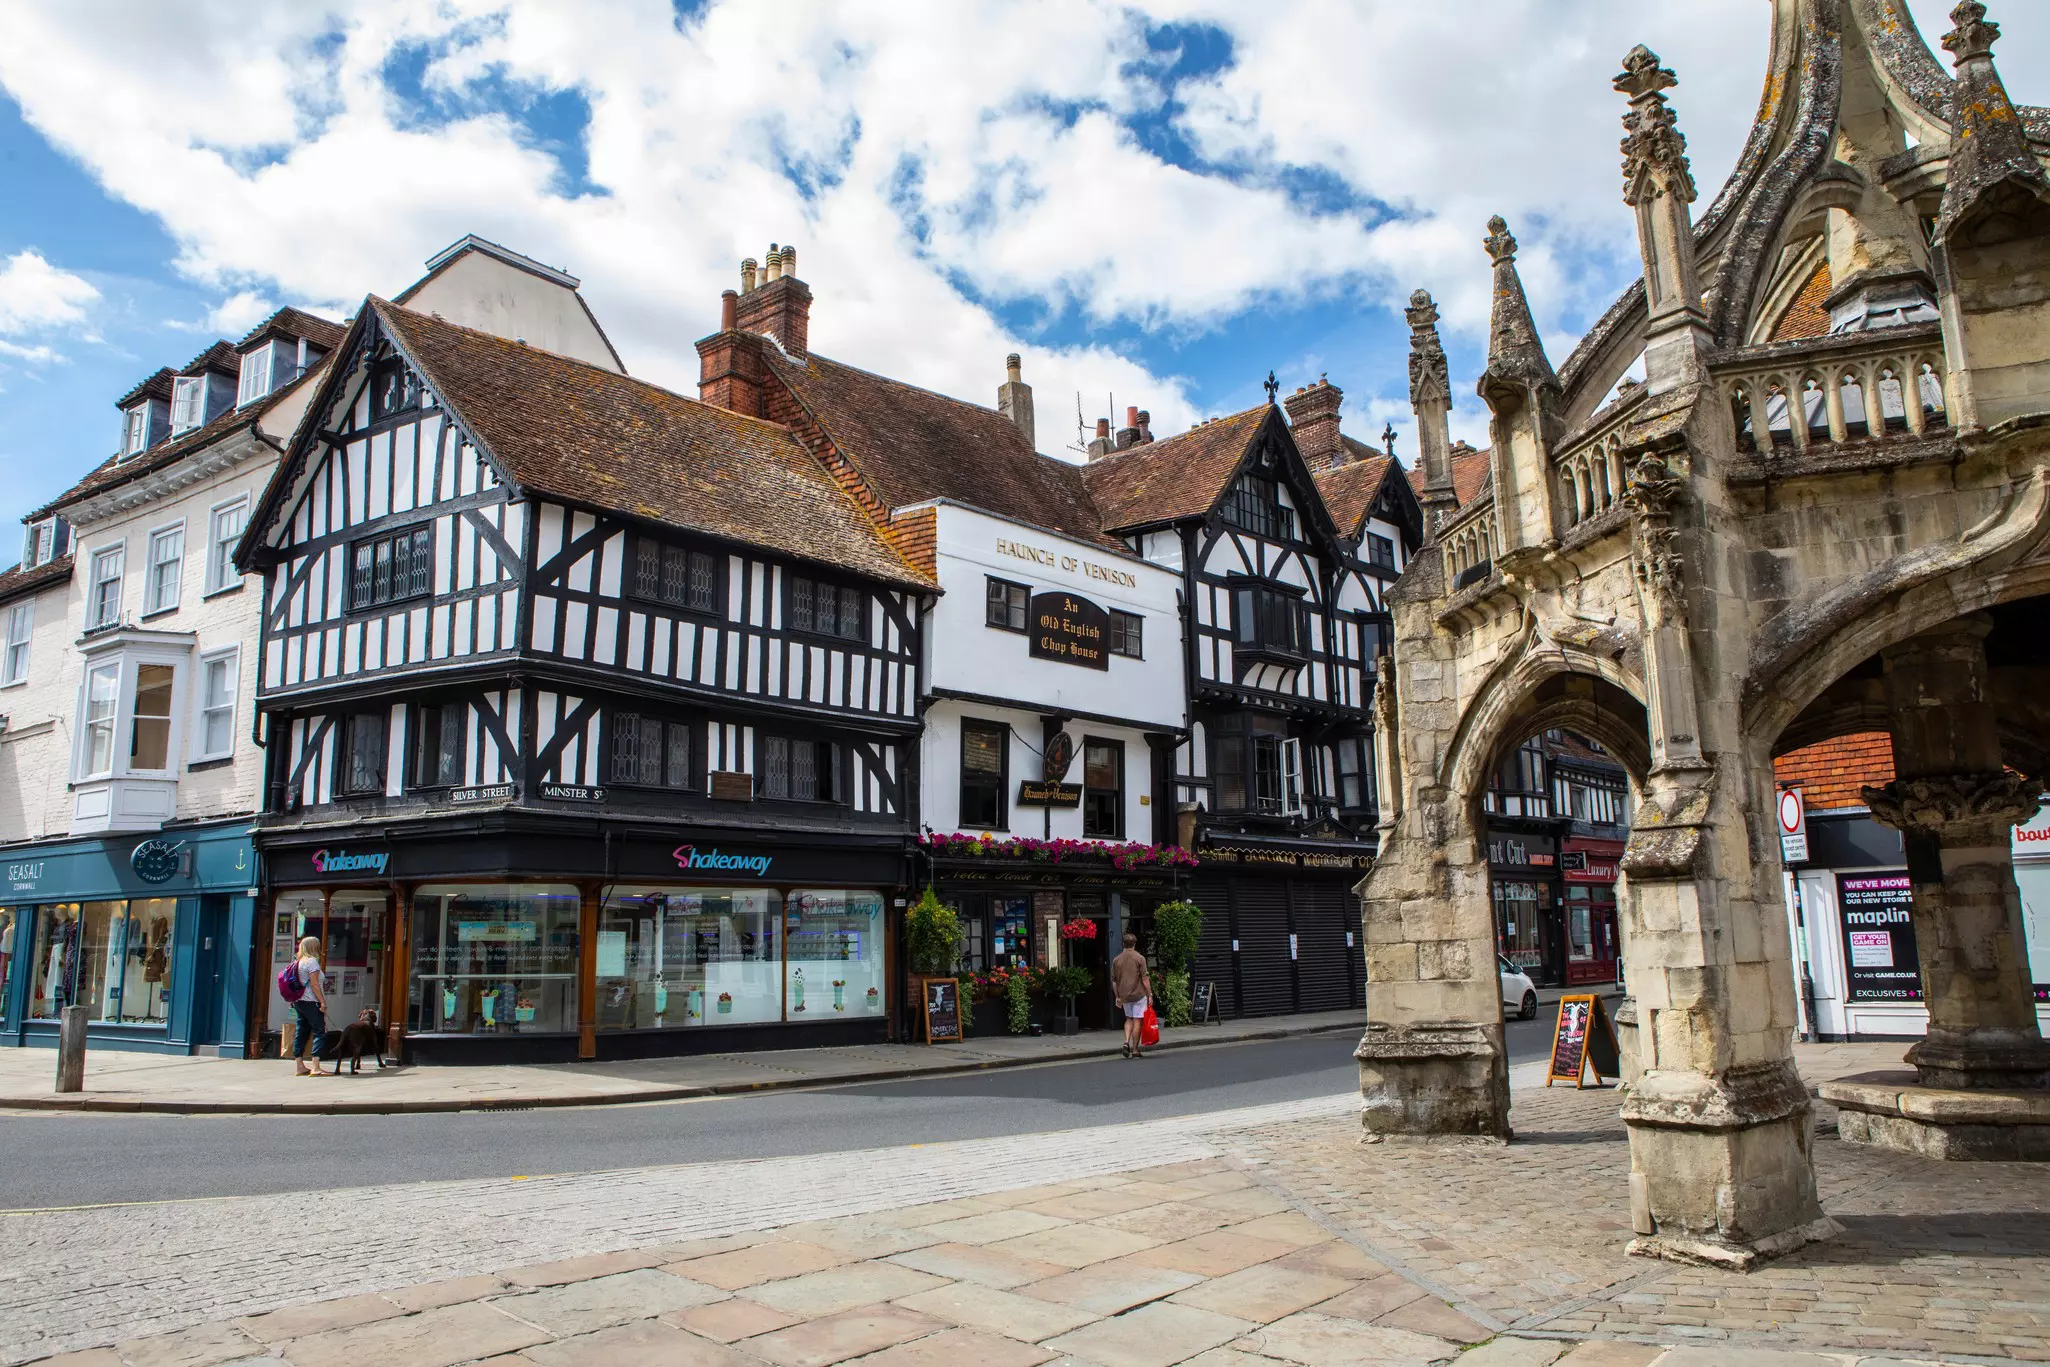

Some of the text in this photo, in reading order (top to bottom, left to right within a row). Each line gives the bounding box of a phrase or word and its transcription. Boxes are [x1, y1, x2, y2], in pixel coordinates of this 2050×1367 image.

[996, 537, 1136, 588] HAUNCH OF VENISON
[1063, 598, 1079, 613] An
[1040, 615, 1100, 640] Old English
[1041, 636, 1099, 659] Chop House
[452, 786, 510, 801] SILVER STREET
[544, 786, 588, 799] MINSTER
[1024, 785, 1049, 801] Haunch
[1053, 787, 1078, 801] Venison
[136, 840, 178, 858] SEASAT
[1506, 839, 1527, 865] Cut
[311, 849, 390, 875] Shakeaway
[672, 844, 773, 877] Shakeaway
[8, 862, 44, 881] SEASALT
[1587, 863, 1611, 880] Luxury
[13, 882, 36, 891] CORNWALL
[1845, 879, 1878, 889] WE'VE
[1847, 907, 1910, 926] maplin
[1856, 989, 1907, 997] EXCLUSIVES
